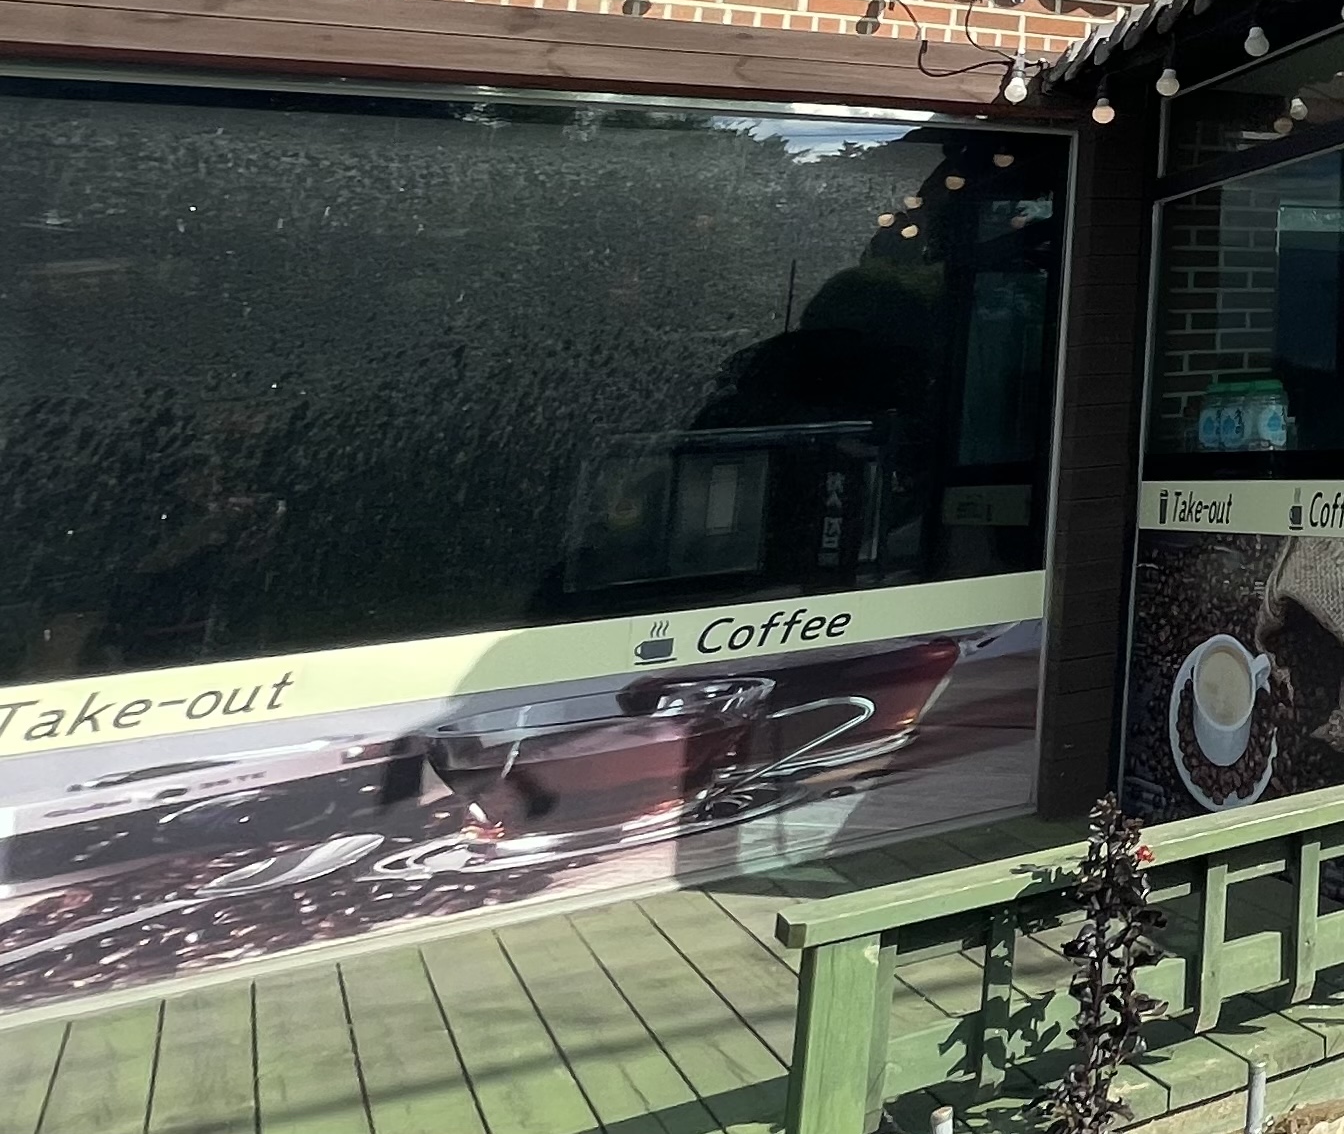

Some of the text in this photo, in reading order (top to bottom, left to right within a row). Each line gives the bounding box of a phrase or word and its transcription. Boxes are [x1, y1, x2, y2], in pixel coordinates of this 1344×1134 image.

[1172, 491, 1234, 525] Take-out
[697, 608, 853, 654] Coffee
[0, 670, 294, 743] Take-out
